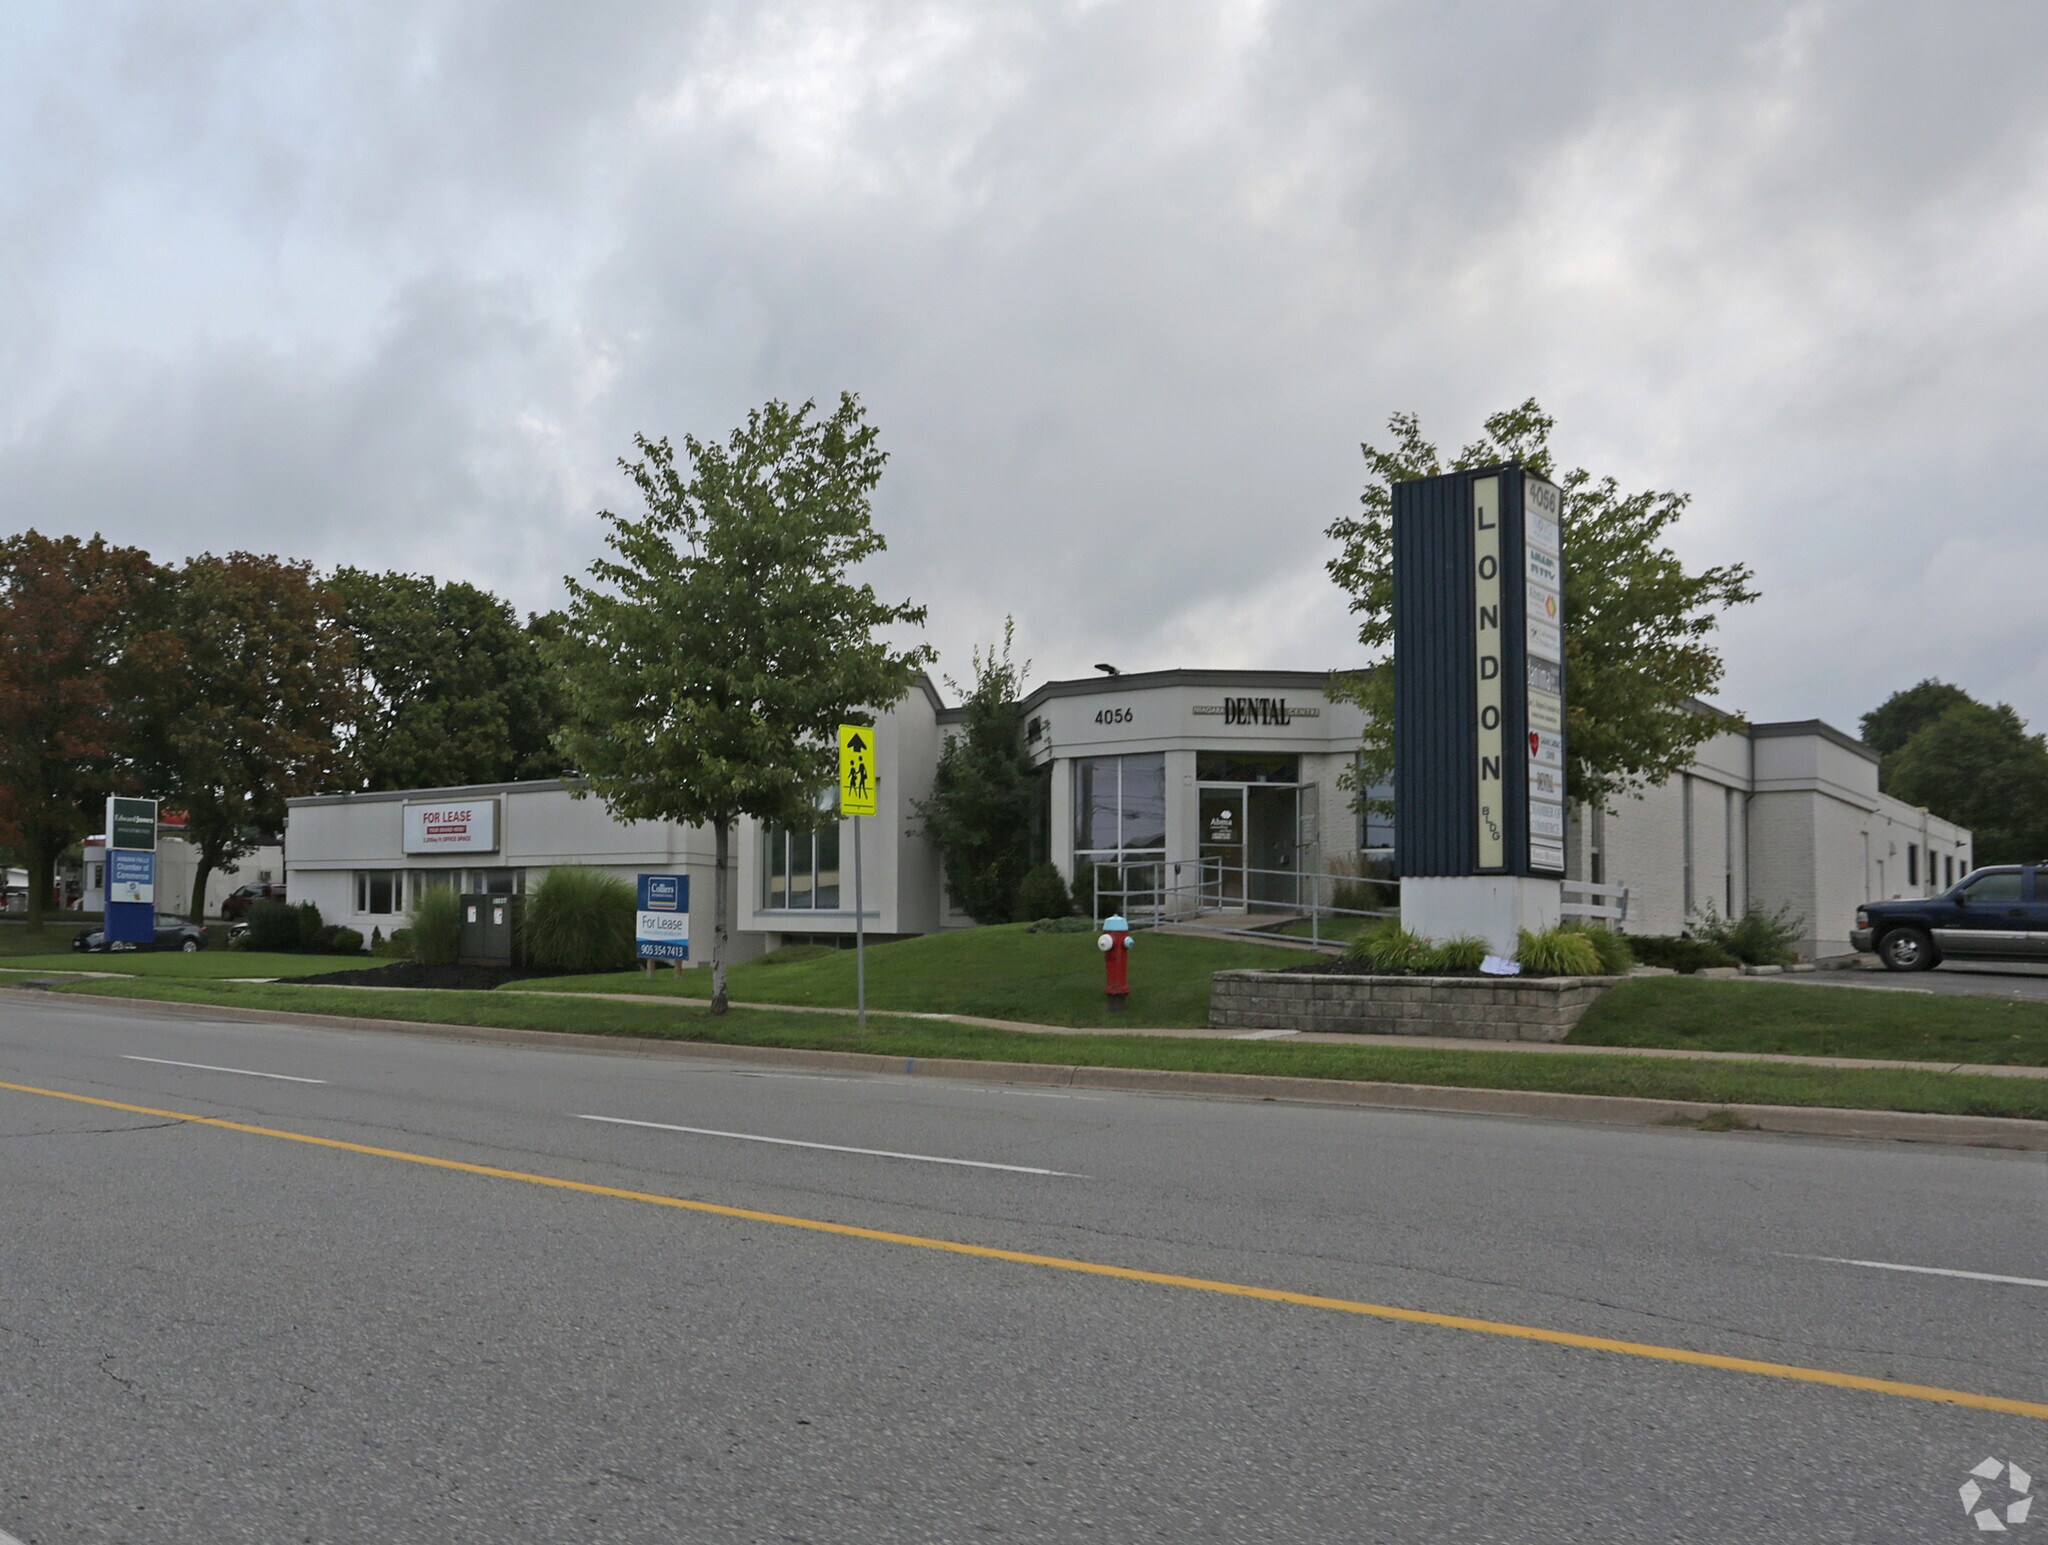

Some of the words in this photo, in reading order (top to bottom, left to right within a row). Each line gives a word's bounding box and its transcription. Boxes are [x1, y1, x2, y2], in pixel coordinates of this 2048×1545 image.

[1530, 483, 1556, 513] 4056
[1478, 507, 1500, 780] LONDON
[1095, 708, 1133, 725] 4056
[1224, 697, 1291, 726] DENTAL
[423, 812, 440, 824] FOR
[443, 810, 472, 823] LEASE
[1482, 806, 1500, 841] BLDG
[651, 883, 674, 893] Colliers
[642, 915, 656, 929] For
[657, 916, 683, 930] Lease
[640, 944, 653, 955] 905
[654, 945, 666, 956] 354
[666, 946, 683, 957] 7413
